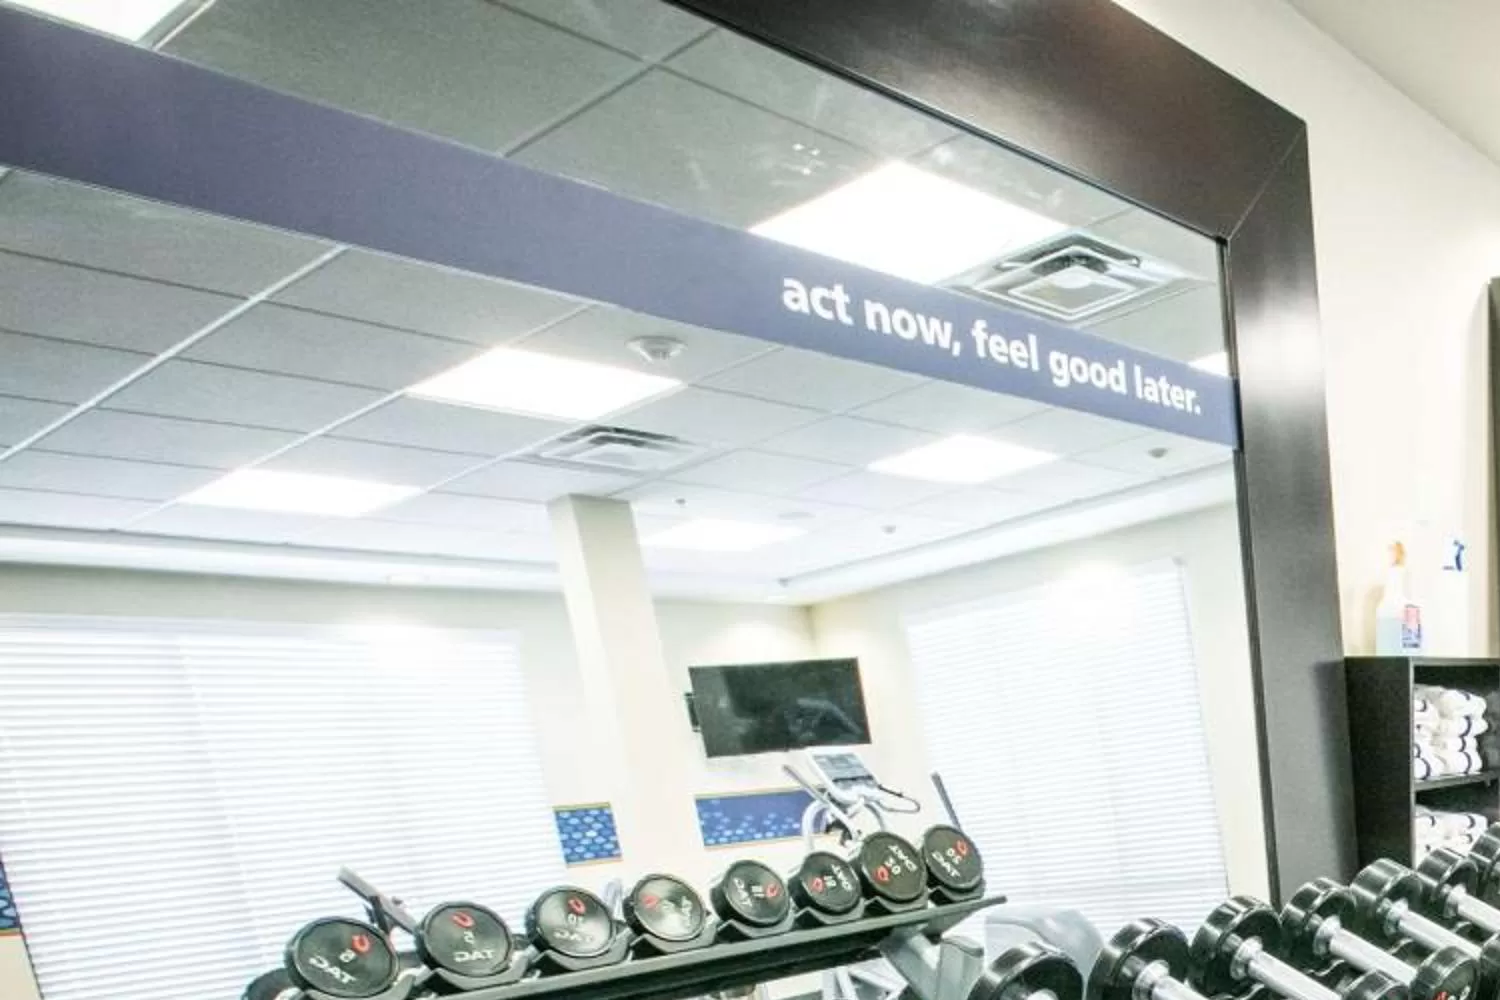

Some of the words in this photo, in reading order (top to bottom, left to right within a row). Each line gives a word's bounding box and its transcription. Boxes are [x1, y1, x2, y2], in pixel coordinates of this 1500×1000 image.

[782, 277, 854, 326] act
[863, 299, 961, 357] now,
[970, 318, 1040, 373] feel
[1049, 350, 1128, 395] good
[1133, 363, 1202, 415] later.
